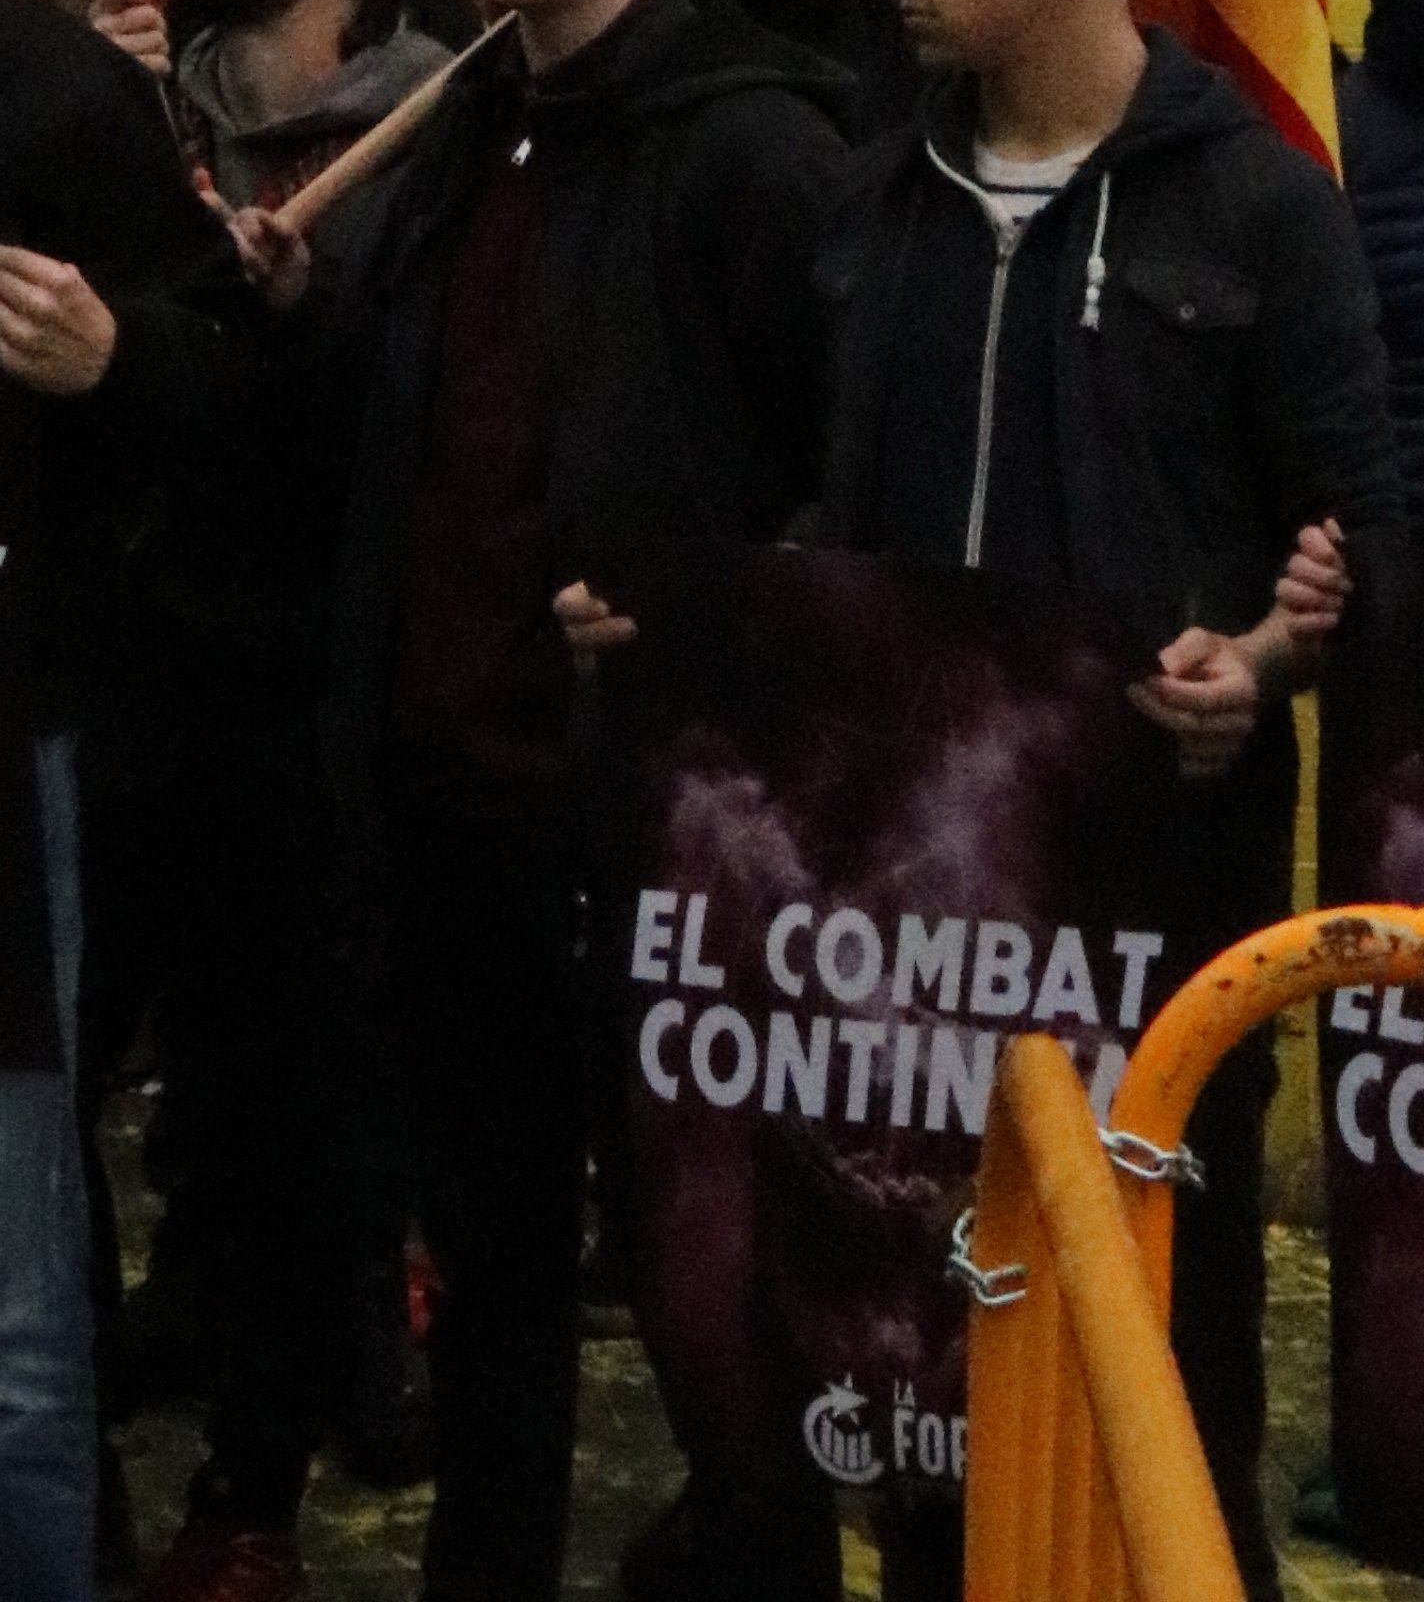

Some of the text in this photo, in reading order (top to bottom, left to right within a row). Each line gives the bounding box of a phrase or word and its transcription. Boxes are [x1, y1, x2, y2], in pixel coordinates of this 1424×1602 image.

[630, 889, 1163, 1028] EL COMBAT
[638, 1000, 1130, 1136] CONTIN
[893, 1408, 968, 1480] FOR
